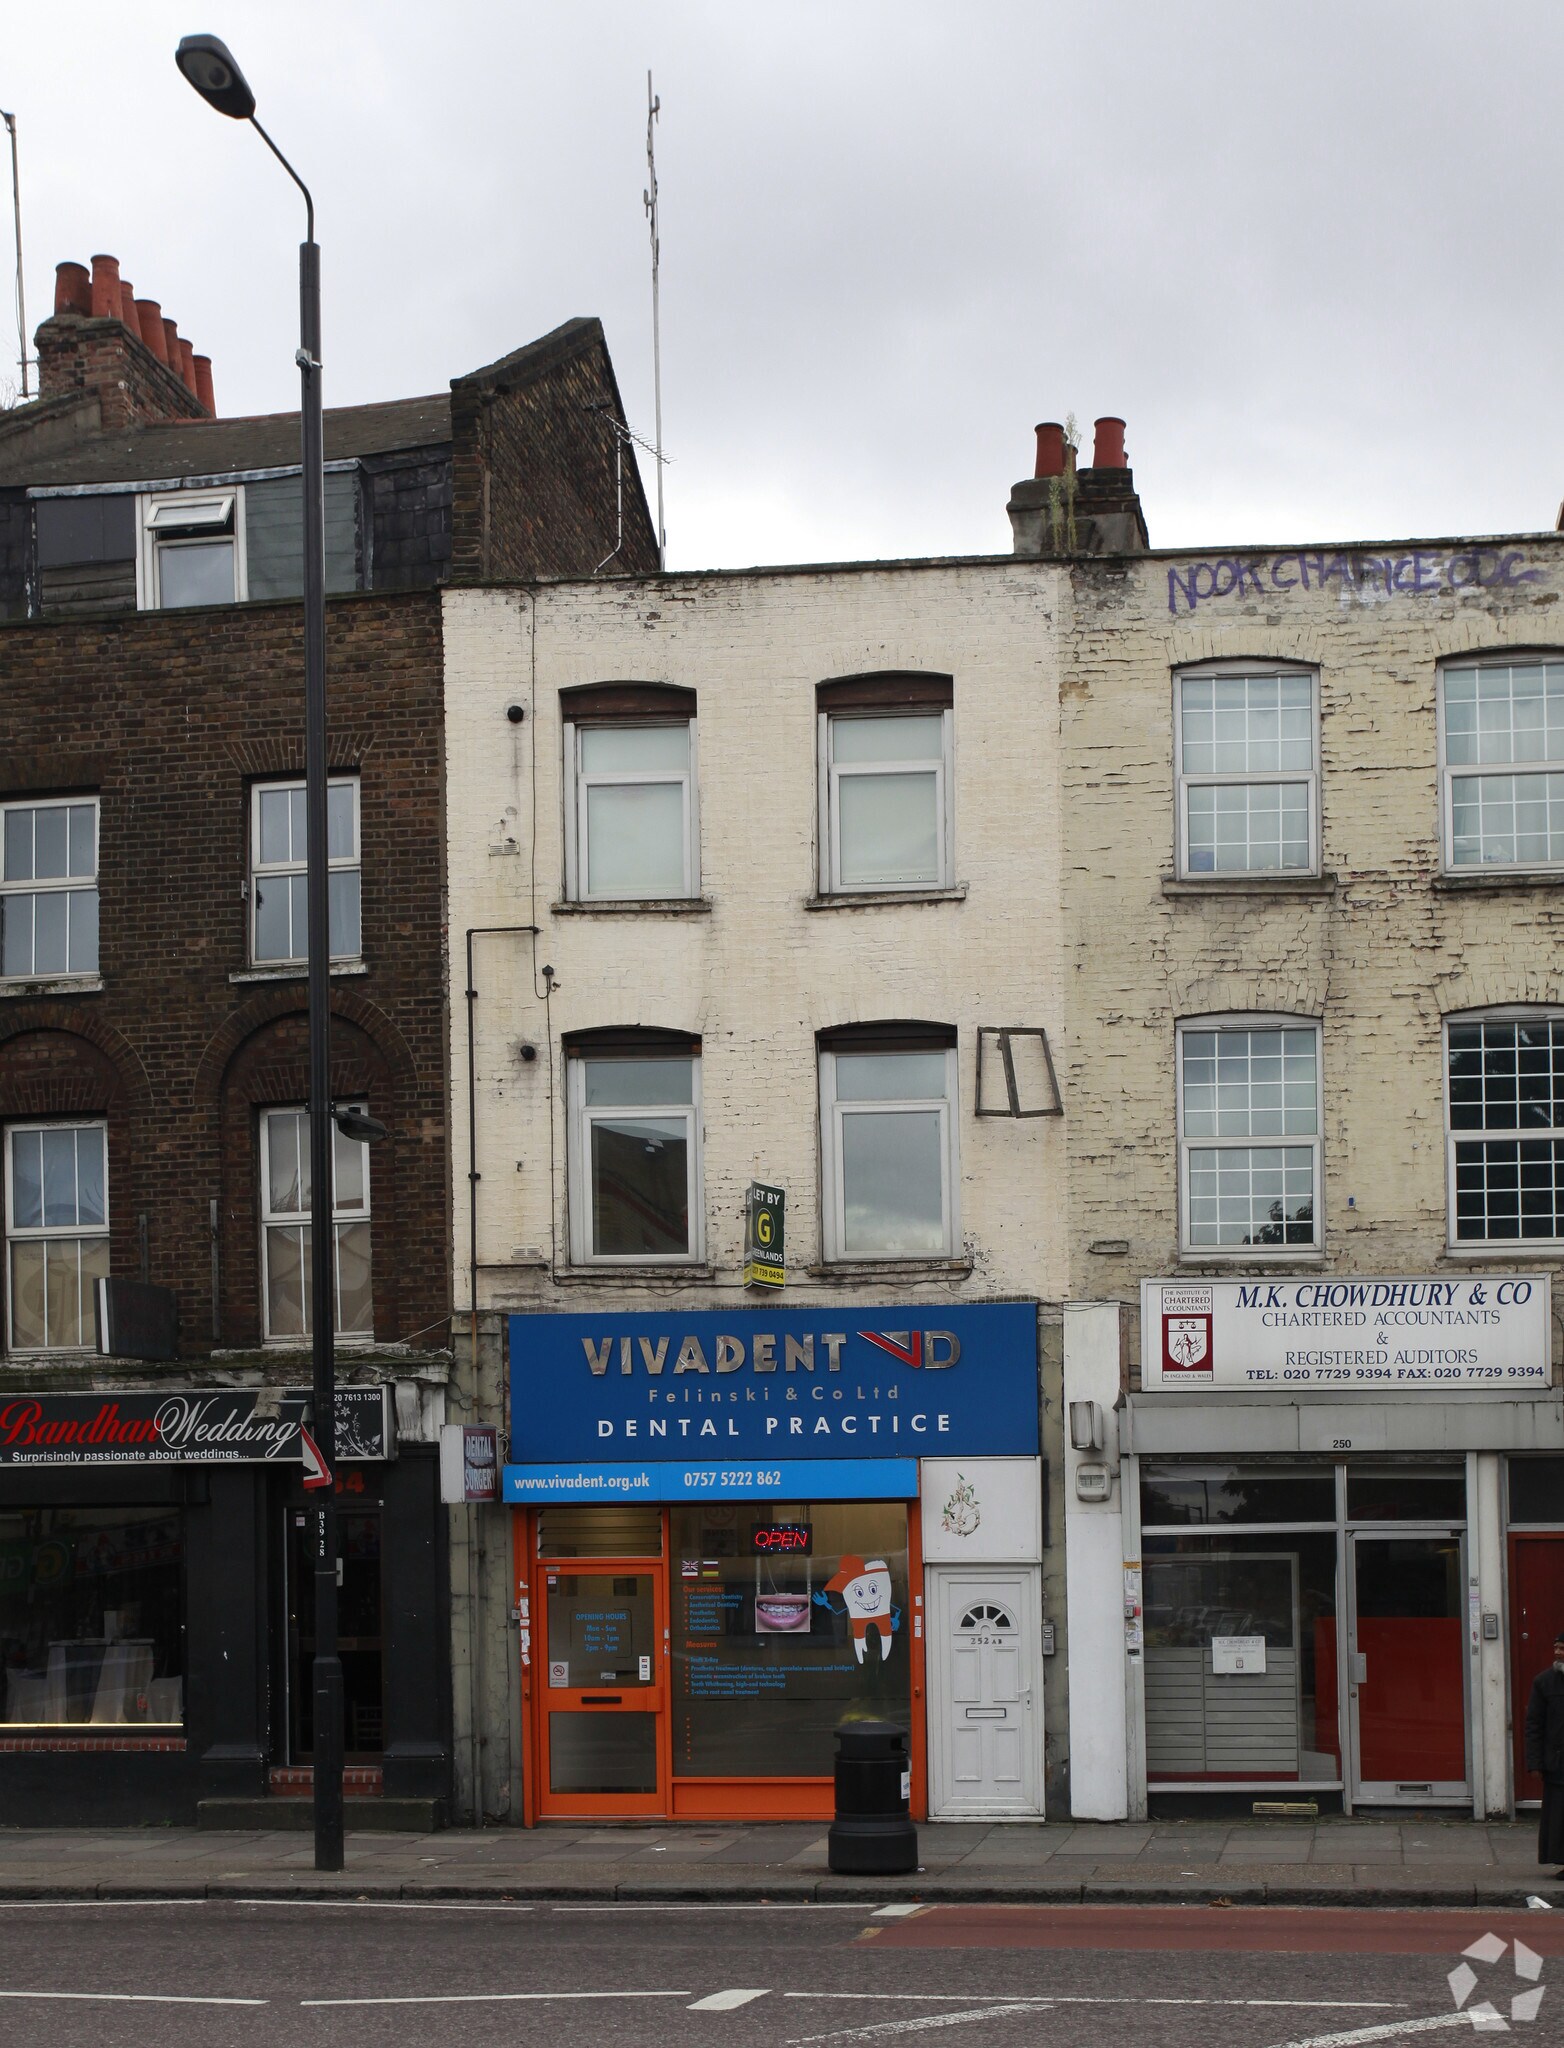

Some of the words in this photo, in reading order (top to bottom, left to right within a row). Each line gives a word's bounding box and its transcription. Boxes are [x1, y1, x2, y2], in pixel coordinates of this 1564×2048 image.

[754, 1187, 765, 1202] LET
[767, 1192, 780, 1206] BY
[758, 1213, 771, 1243] G
[769, 1270, 784, 1280] 0494
[1236, 1285, 1288, 1308] M.K.
[1295, 1282, 1460, 1308] CHOWDHURY
[1468, 1282, 1488, 1306] &
[1496, 1281, 1532, 1306] CO
[1262, 1311, 1366, 1327] CHARTERED
[1373, 1310, 1501, 1326] ACCOUNTANTS
[1376, 1331, 1389, 1345] &
[581, 1333, 847, 1376] VIVADENT
[1285, 1350, 1388, 1366] REGISTERED
[1393, 1348, 1478, 1364] AUDITORS
[1246, 1369, 1278, 1380] TEL:
[1283, 1369, 1311, 1380] 020
[1315, 1368, 1351, 1379] 7729
[1355, 1368, 1392, 1379] 9394
[1397, 1368, 1431, 1379] FAX:
[1434, 1367, 1461, 1378] 020
[1466, 1366, 1502, 1378] 7729
[1507, 1366, 1544, 1377] 9394
[344, 1393, 361, 1401] 7613
[363, 1393, 381, 1401] 1300
[649, 1387, 769, 1402] Felinski
[786, 1387, 798, 1401] &
[811, 1386, 843, 1400] Co
[857, 1385, 898, 1400] Ltd
[0, 1399, 162, 1446] Bandhan
[154, 1397, 300, 1459] Wedding
[598, 1418, 739, 1438] DENTAL
[766, 1414, 950, 1435] PRACTICE
[466, 1436, 493, 1458] DENTAL
[1332, 1439, 1352, 1449] 250
[12, 1451, 81, 1462] Surprisingly
[84, 1450, 146, 1462] passionate
[148, 1449, 182, 1460] about
[465, 1469, 496, 1491] SURGERY
[514, 1472, 650, 1491] www.vivadent.org.uk
[684, 1472, 716, 1487] 0757
[720, 1471, 753, 1486] 5222
[756, 1471, 781, 1486] 862
[755, 1531, 808, 1548] OPEN
[696, 1585, 725, 1593] services:
[605, 1612, 627, 1620] HOURS
[586, 1624, 600, 1632] Mon
[605, 1624, 617, 1632] Sun
[685, 1640, 717, 1648] Measures
[970, 1637, 989, 1645] 252
